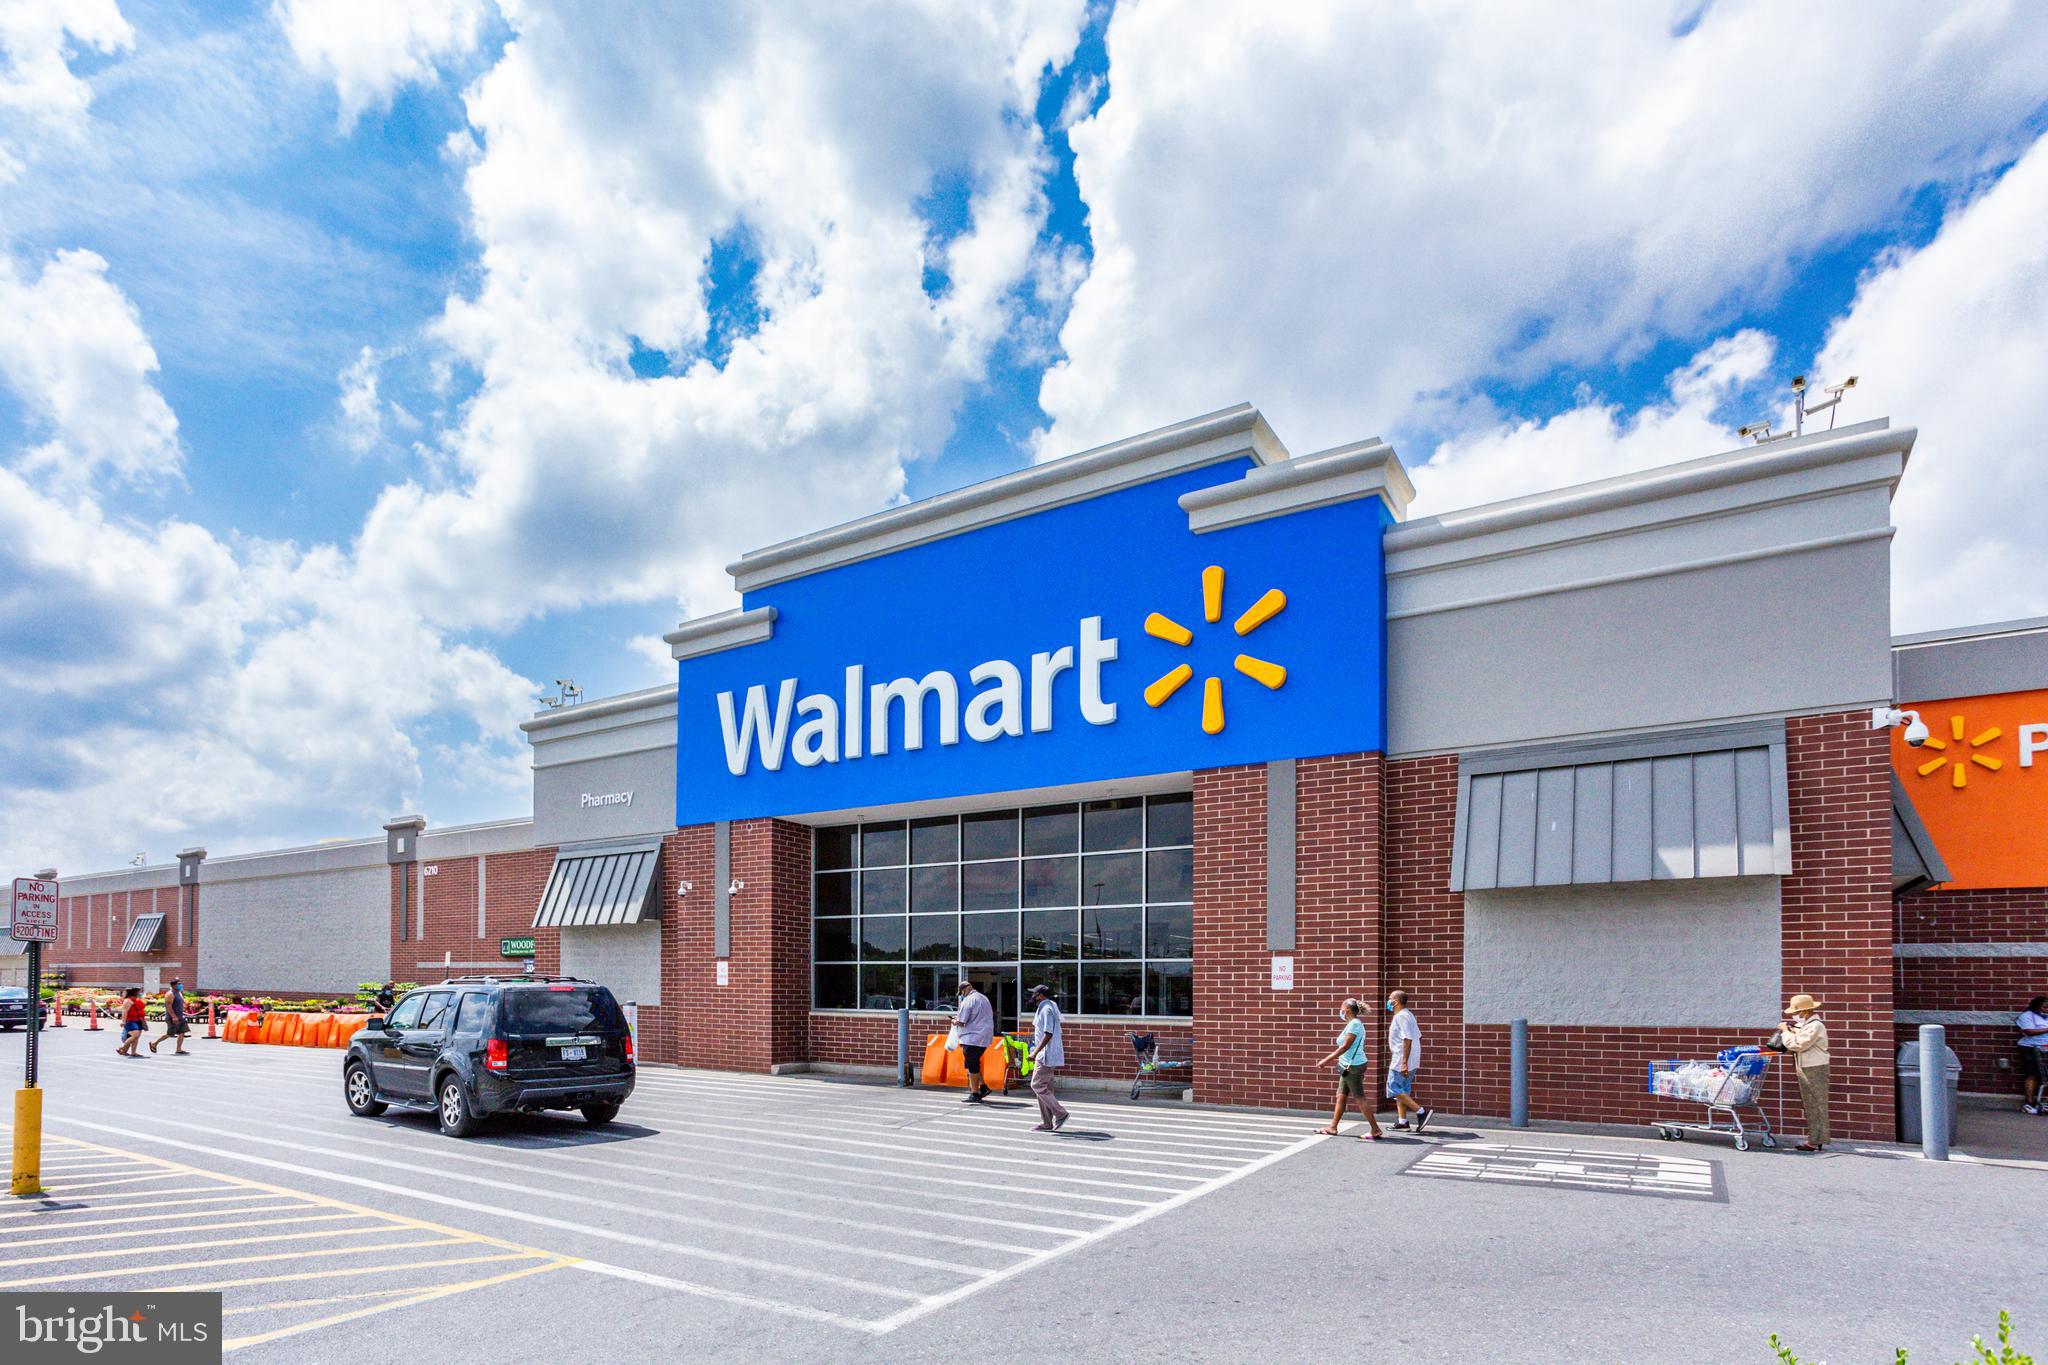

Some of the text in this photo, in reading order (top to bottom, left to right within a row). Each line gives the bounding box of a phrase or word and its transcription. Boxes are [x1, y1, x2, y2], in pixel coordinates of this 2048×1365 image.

[717, 615, 1118, 776] Walmart
[581, 791, 634, 808] Pharmacy
[424, 865, 438, 875] 6210
[30, 883, 44, 892] NO
[18, 893, 55, 903] PARKING
[21, 910, 52, 919] ACCESS
[16, 926, 56, 938] $200 FINE
